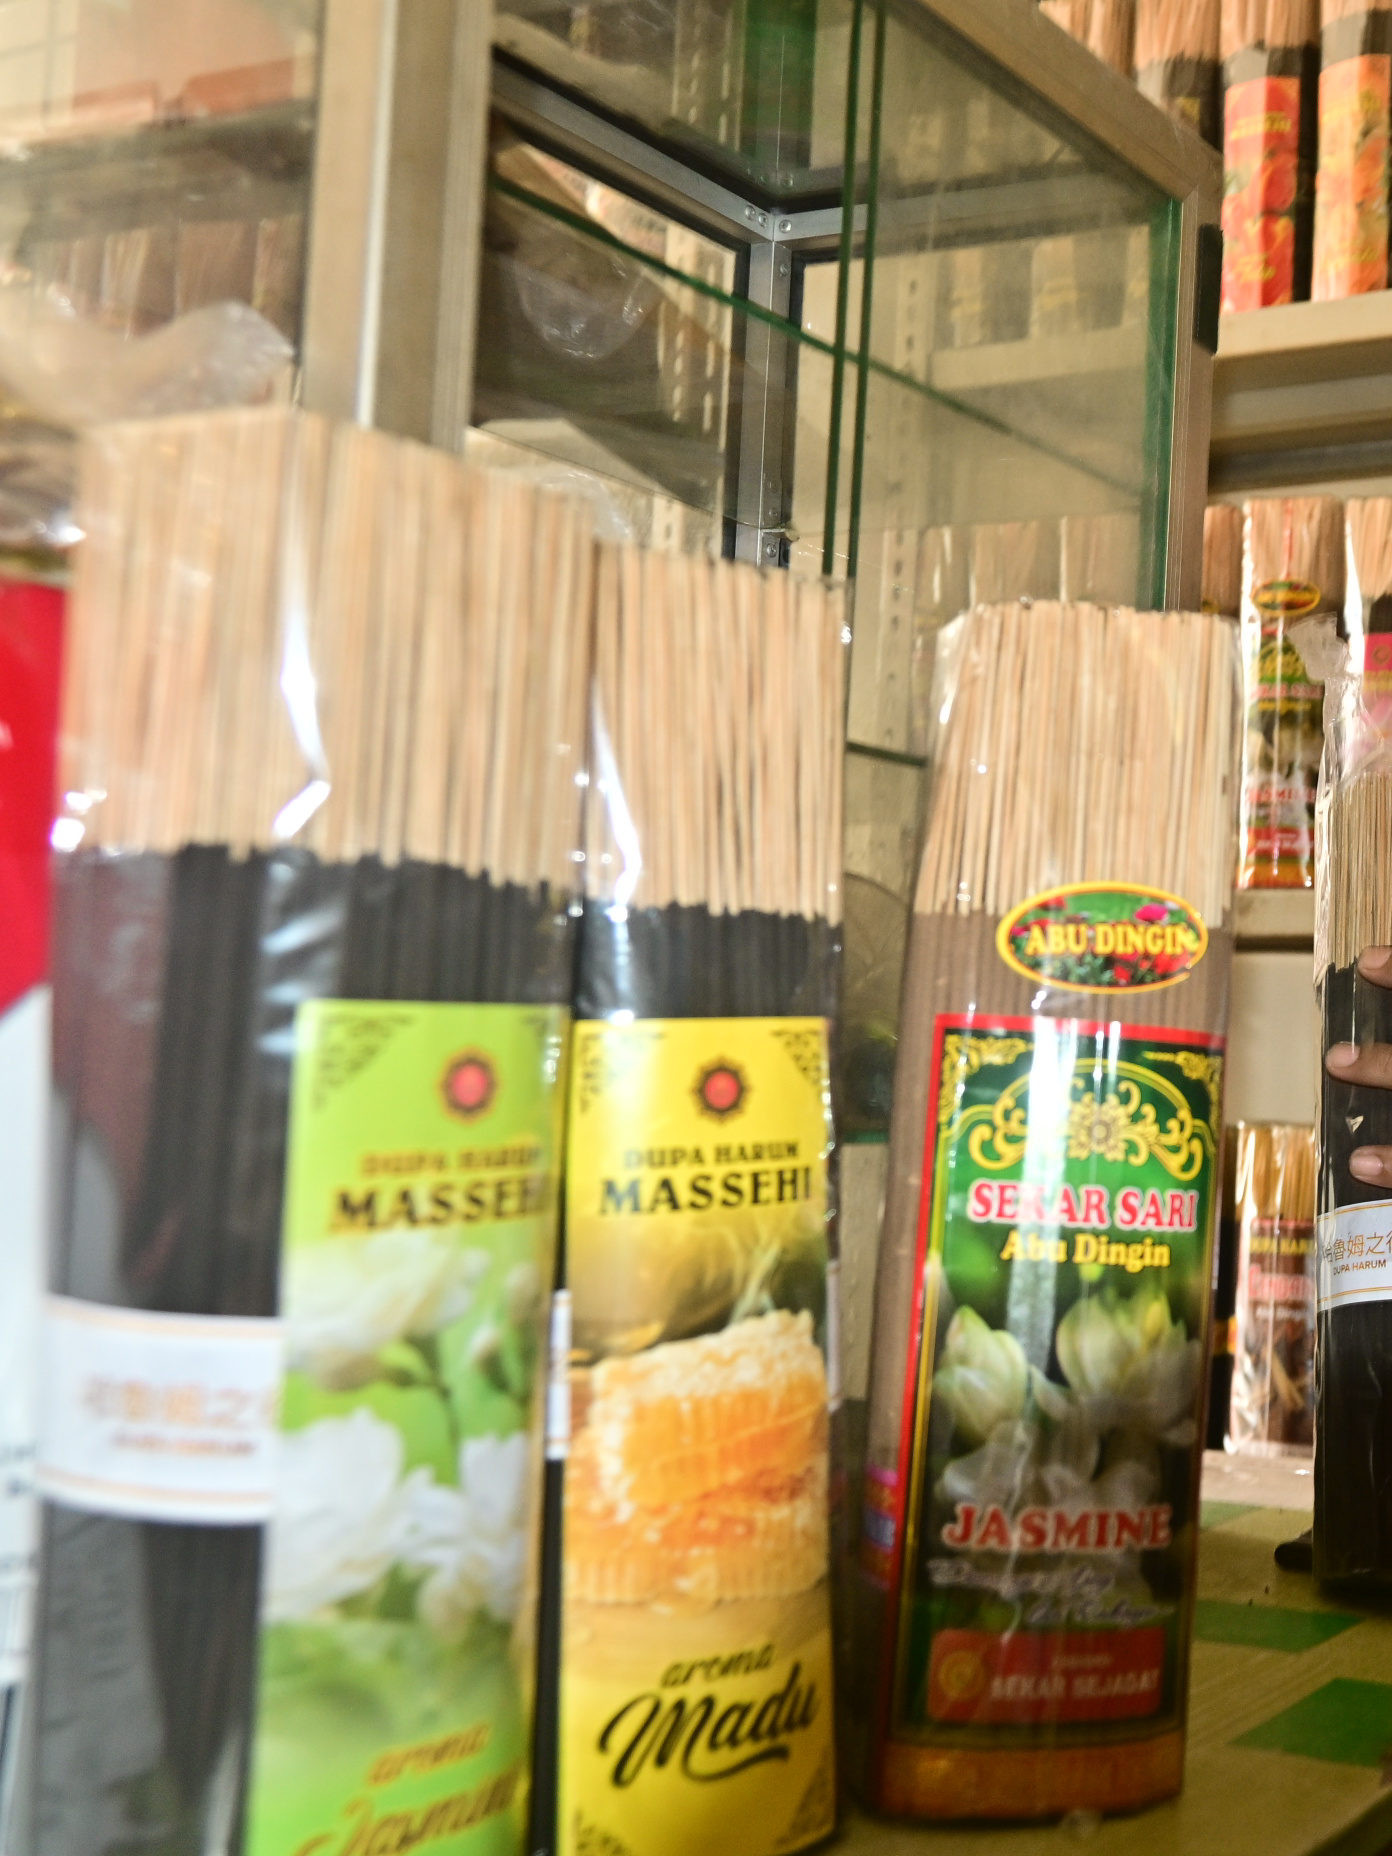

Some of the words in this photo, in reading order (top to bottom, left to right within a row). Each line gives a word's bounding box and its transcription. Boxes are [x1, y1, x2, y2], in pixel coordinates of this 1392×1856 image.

[1025, 923, 1089, 956] ABU
[1093, 923, 1199, 956] DINGIN
[623, 1145, 706, 1171] DUPA
[713, 1140, 799, 1164] HARUM
[600, 1166, 812, 1214] MASSEHI
[1114, 1187, 1199, 1232] SARI
[1000, 1229, 1068, 1263] Abu
[1072, 1232, 1172, 1274] Dingin
[1333, 1263, 1350, 1276] DUPA
[1352, 1258, 1387, 1272] HARUM
[942, 1502, 1173, 1550] JASMINE
[660, 1644, 775, 1690] aroma
[596, 1660, 817, 1789] Madu
